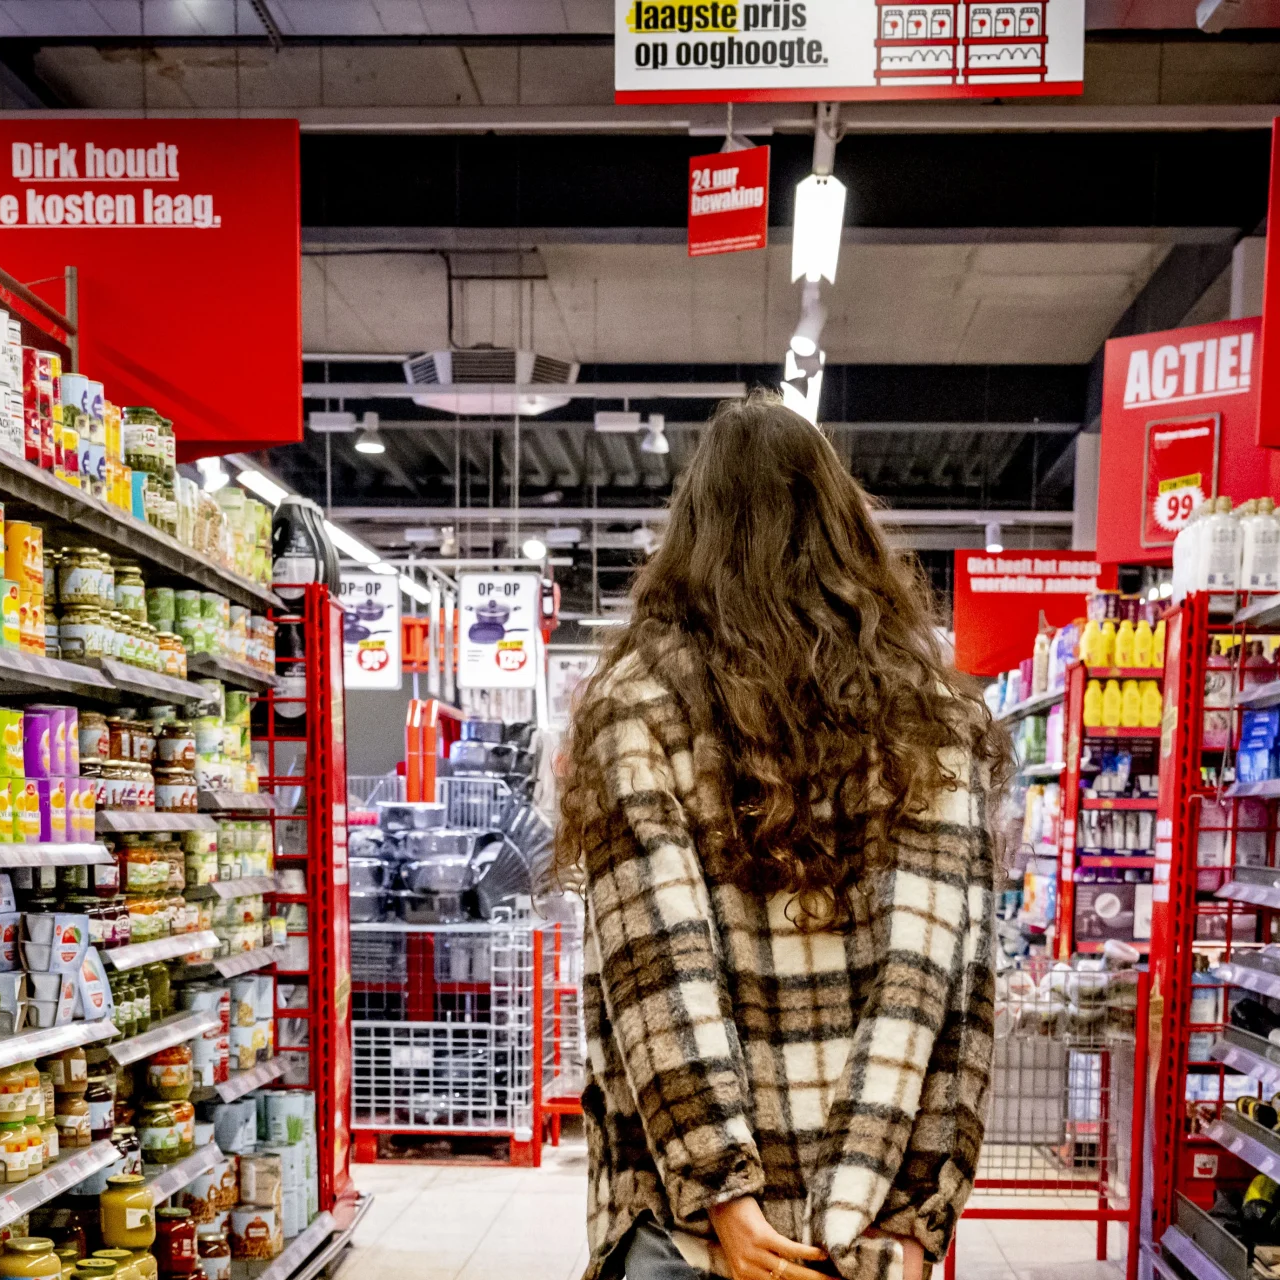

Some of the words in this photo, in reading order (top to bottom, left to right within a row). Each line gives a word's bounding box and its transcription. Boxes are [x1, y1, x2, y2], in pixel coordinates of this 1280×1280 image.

[635, 0, 737, 33] laagste
[744, 2, 807, 31] prijs
[635, 42, 668, 69] op
[676, 36, 829, 68] ooghoogte.
[12, 142, 78, 177] Dirk
[85, 142, 179, 178] houdt
[692, 168, 711, 190] 24
[713, 167, 739, 188] uur
[26, 188, 136, 225] kosten
[143, 188, 221, 228] laag.
[691, 186, 764, 216] bewaking
[1123, 332, 1254, 403] ACTIE!
[1167, 494, 1194, 521] 99
